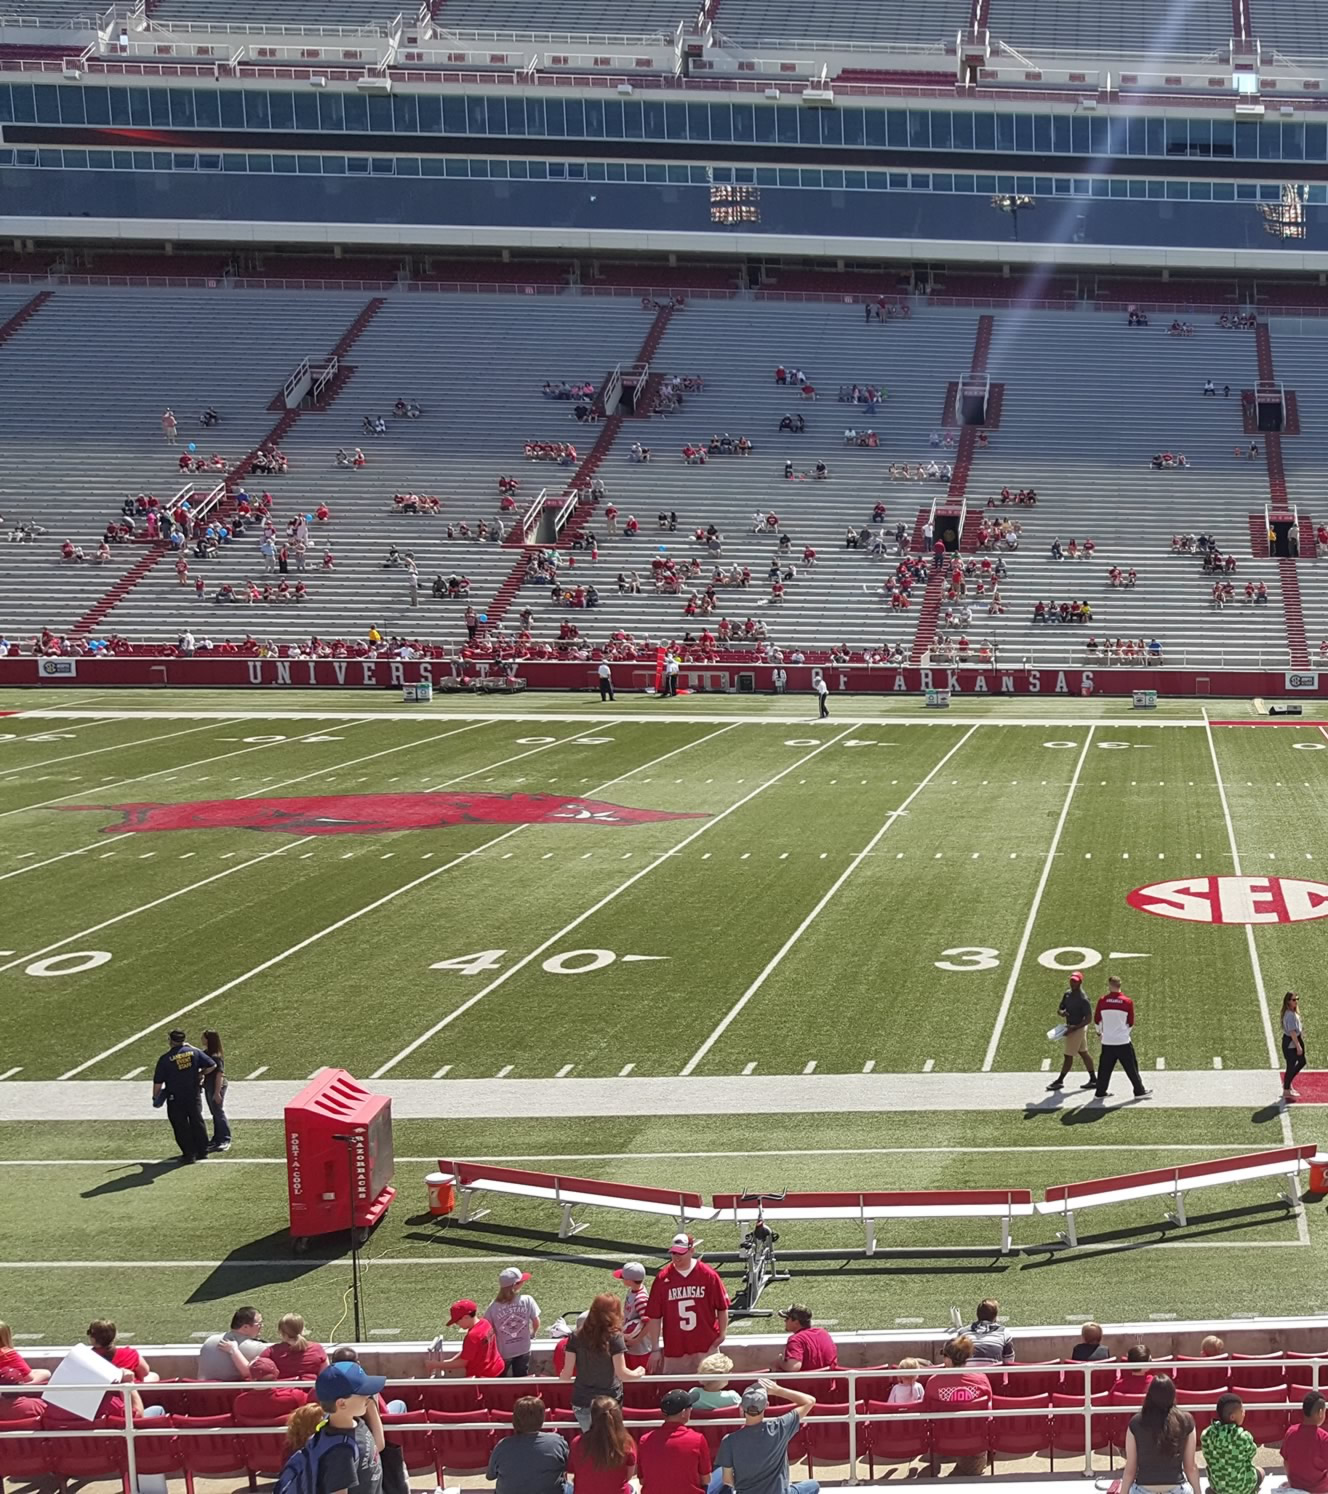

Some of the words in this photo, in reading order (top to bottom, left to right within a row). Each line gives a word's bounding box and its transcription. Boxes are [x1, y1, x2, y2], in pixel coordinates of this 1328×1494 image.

[893, 670, 1094, 692] ARKANSAS
[354, 1135, 367, 1199] RAZORBACKS
[668, 1286, 706, 1300] ARKANSAS
[678, 1300, 697, 1331] 5
